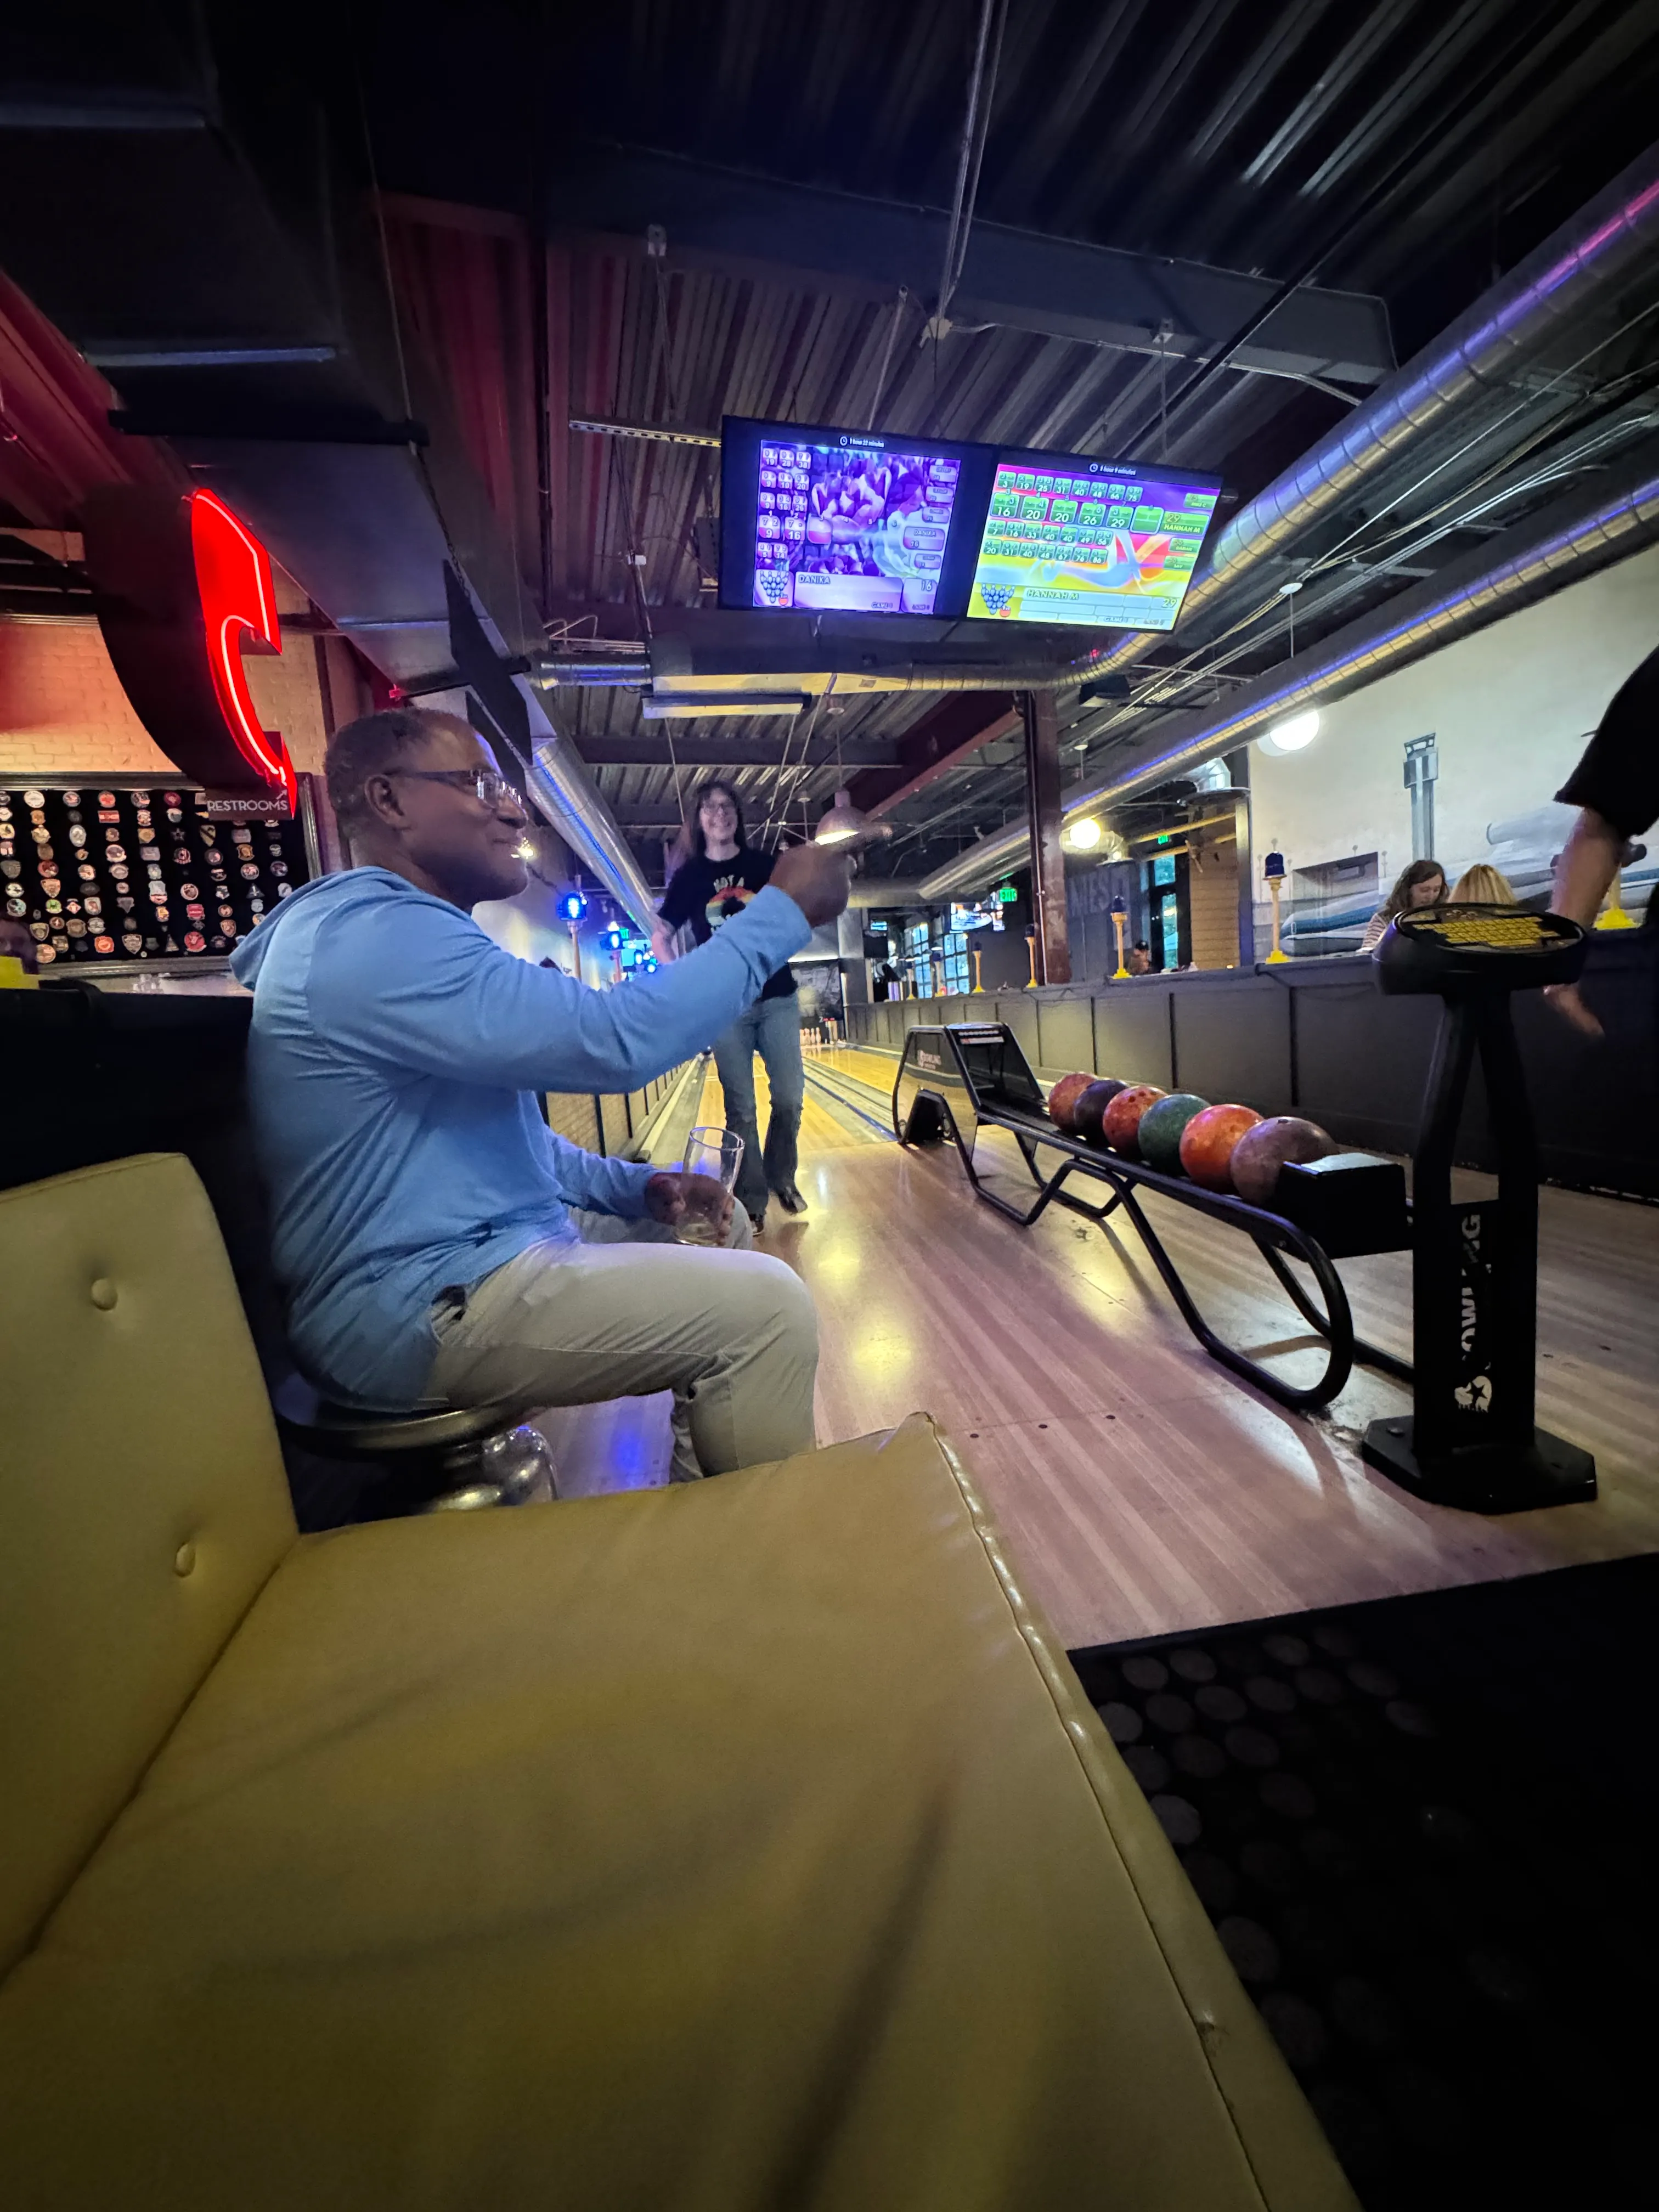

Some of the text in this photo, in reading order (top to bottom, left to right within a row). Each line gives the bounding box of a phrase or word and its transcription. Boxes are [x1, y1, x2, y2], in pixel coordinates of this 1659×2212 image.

[998, 506, 1011, 516] 16
[1026, 510, 1041, 520] 20
[762, 517, 778, 527] 7 2
[1054, 513, 1069, 522] 20
[1083, 516, 1097, 526] 26
[1166, 514, 1181, 523] 29
[788, 520, 794, 528] 7
[1110, 518, 1125, 528] 29
[1164, 524, 1192, 533] HANNAH
[766, 530, 772, 538] 9
[788, 531, 801, 540] 16
[798, 575, 831, 584] DANIKA
[921, 580, 933, 592] 16
[1027, 589, 1069, 599] HANNAH
[1161, 598, 1177, 608] 29
[207, 799, 288, 811] RESTROOMS
